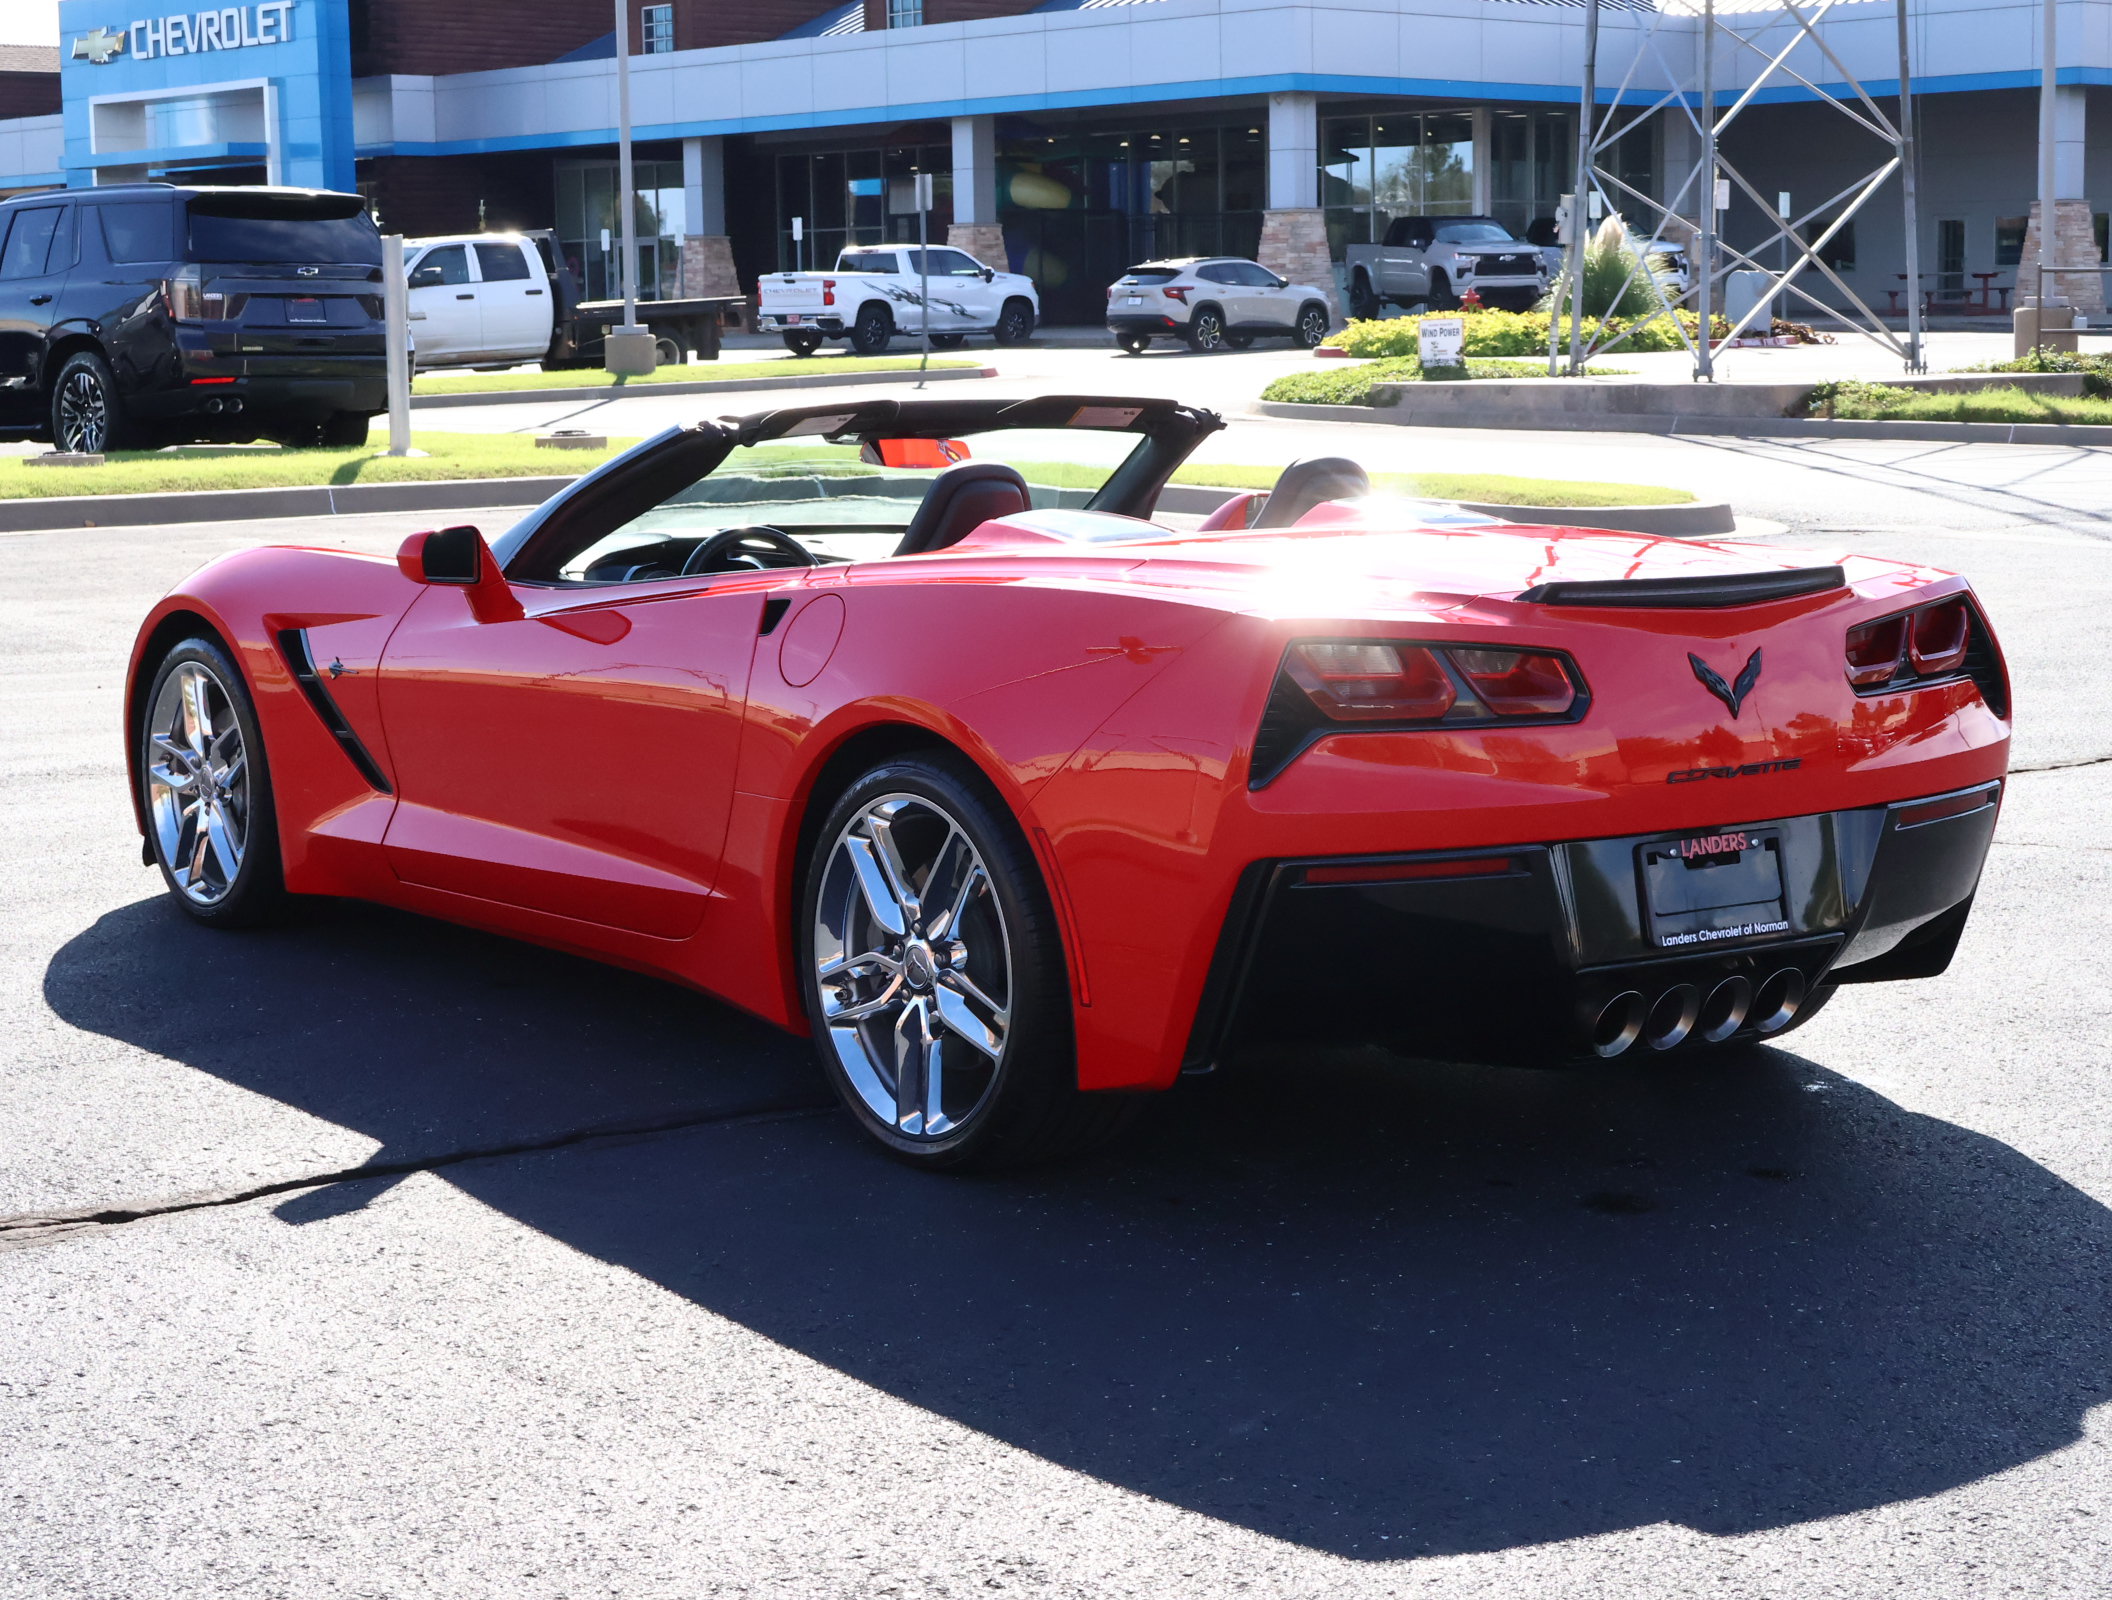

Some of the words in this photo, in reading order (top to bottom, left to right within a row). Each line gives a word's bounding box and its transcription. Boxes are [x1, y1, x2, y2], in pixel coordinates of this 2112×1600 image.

[130, 0, 293, 60] CHEVROLET
[1421, 329, 1438, 338] WIND
[1439, 328, 1460, 337] POWER
[1667, 757, 1802, 784] CORVETTE
[1681, 832, 1748, 859] LANDERS
[1661, 933, 1697, 947] Landers
[1698, 925, 1742, 941] Chevrolet
[1743, 923, 1753, 935] of
[1754, 920, 1789, 934] Norman
